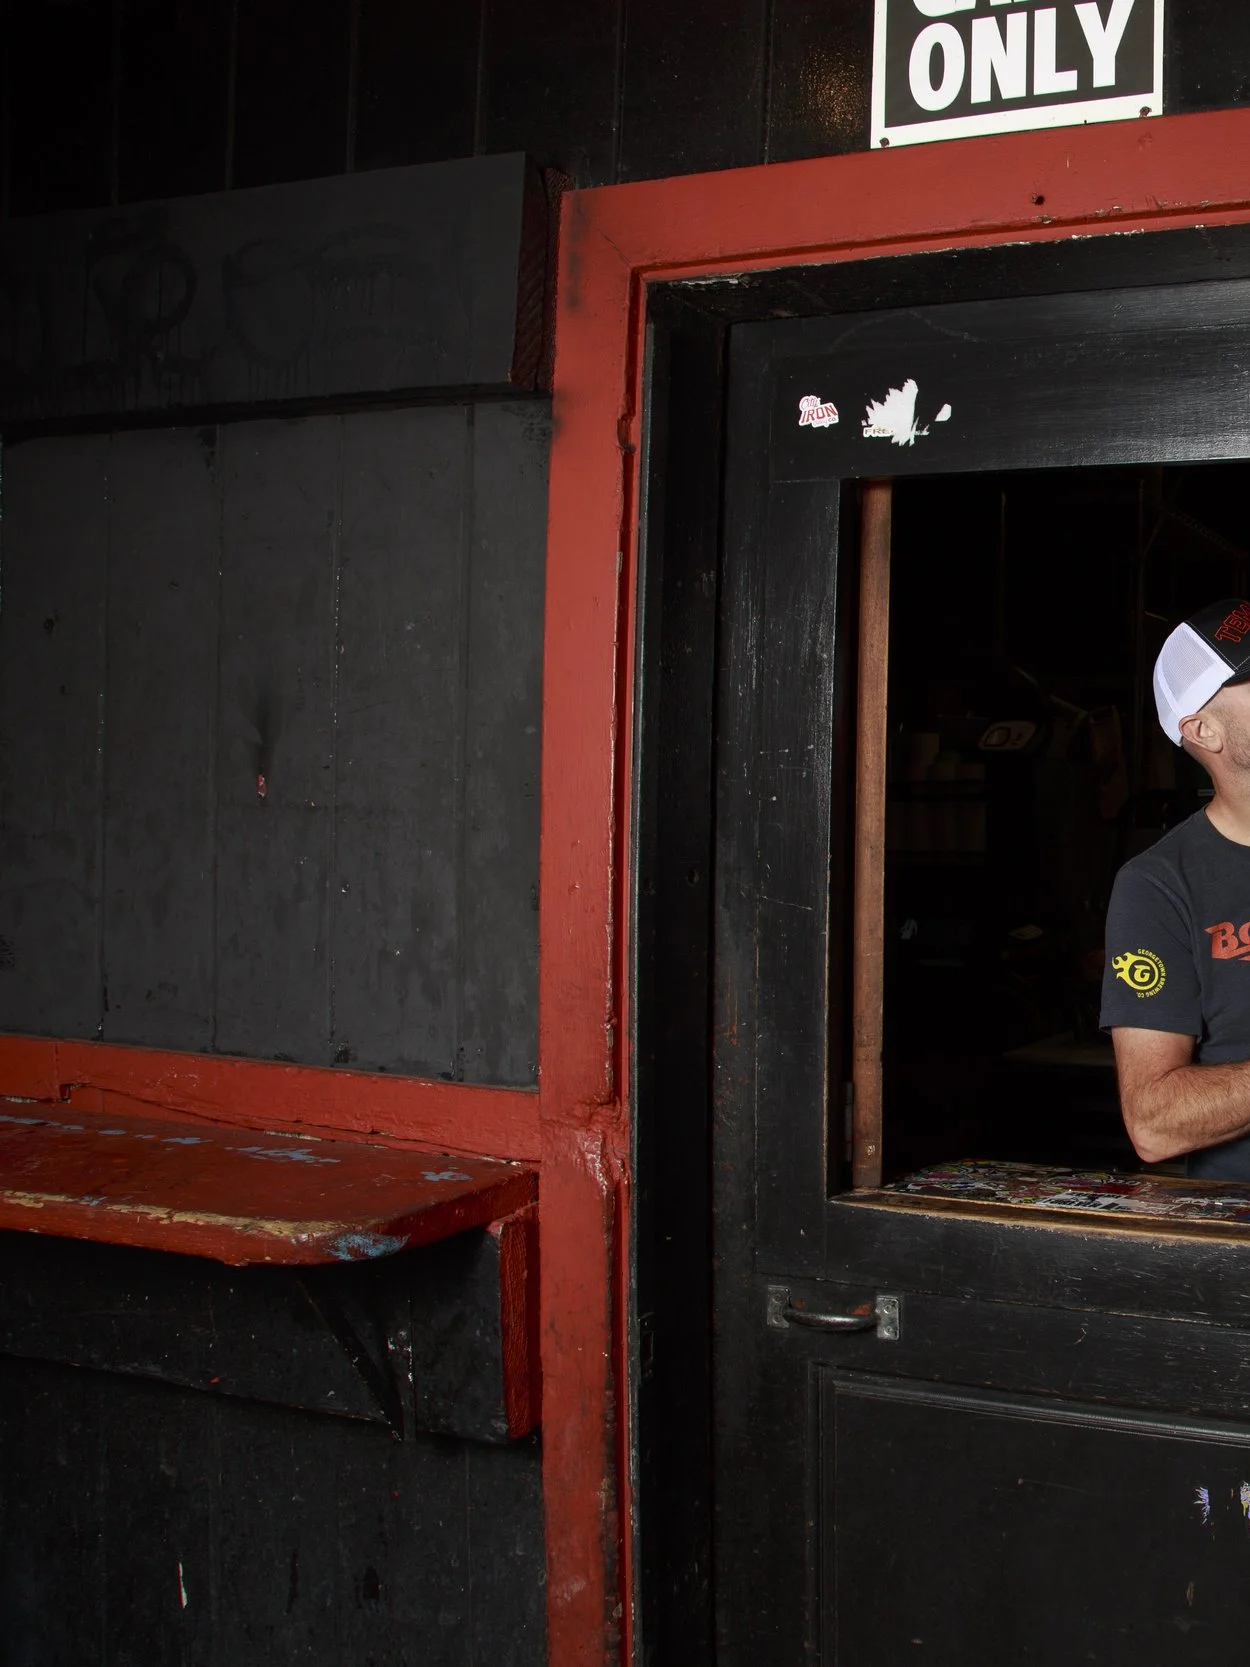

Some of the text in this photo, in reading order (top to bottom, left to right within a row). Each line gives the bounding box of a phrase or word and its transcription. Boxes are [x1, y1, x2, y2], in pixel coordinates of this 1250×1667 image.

[909, 0, 1136, 111] ONLY
[801, 404, 838, 423] IRON
[1137, 948, 1166, 977] GEORGETOWN
